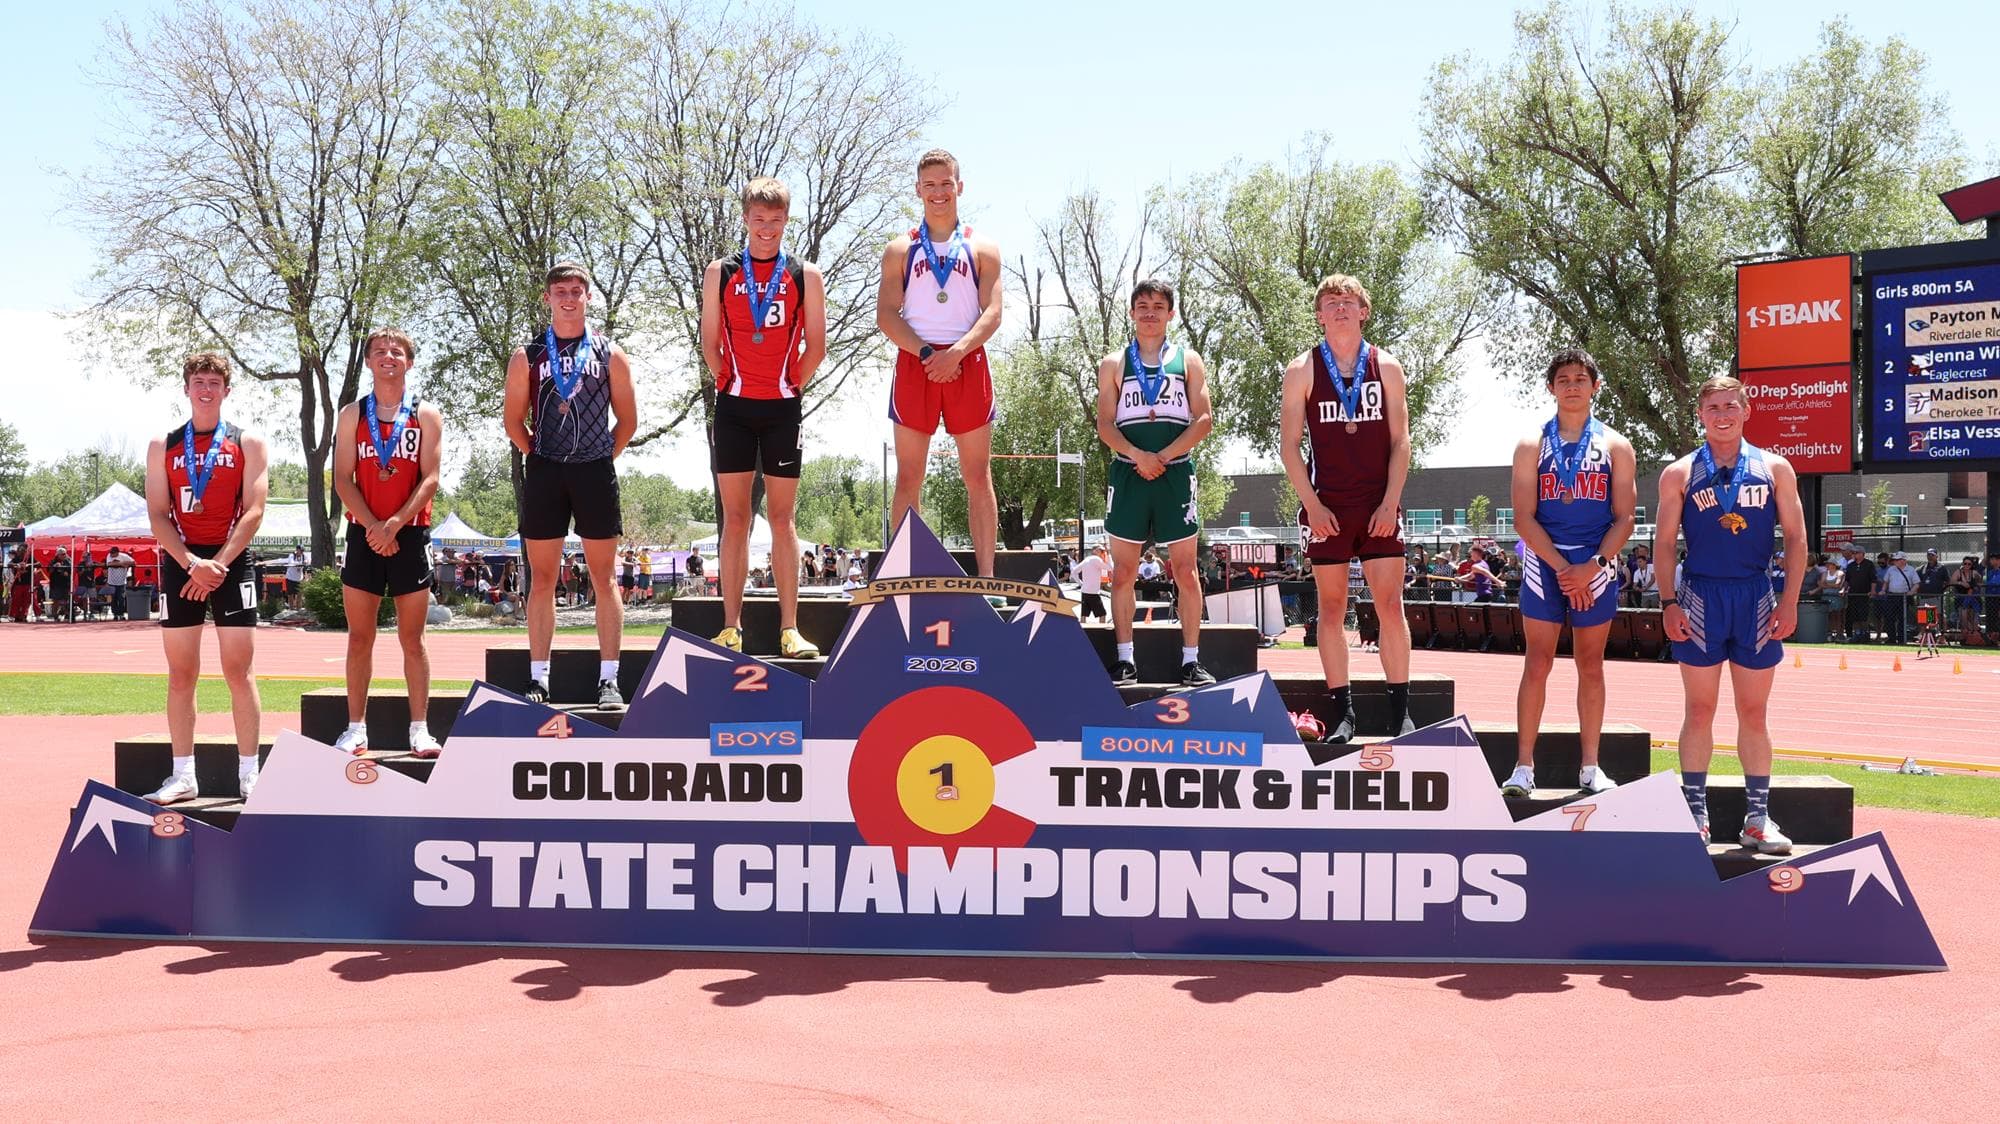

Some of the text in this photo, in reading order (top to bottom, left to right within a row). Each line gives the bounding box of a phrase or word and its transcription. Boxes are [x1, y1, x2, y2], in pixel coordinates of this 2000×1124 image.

[1876, 280, 1974, 299] Girls 800m 5A
[769, 303, 781, 325] 3
[1930, 310, 1985, 326] Payton
[1885, 323, 1892, 336] 1
[1929, 328, 1982, 341] Riverdale
[1885, 361, 1894, 373] 2
[1928, 350, 1975, 365] Jenna
[1929, 368, 1987, 382] Eaglecrest
[1159, 376, 1171, 399] 2
[1366, 383, 1378, 407] 6
[1761, 385, 1788, 400] Prep
[1790, 380, 1848, 399] Spotlight
[1930, 387, 1998, 402] Madison
[1756, 403, 1766, 411] We
[1767, 403, 1784, 411] cover
[1805, 399, 1832, 409] Athletics
[1885, 399, 1894, 412] 3
[1929, 407, 1983, 419] Cherokee
[405, 429, 417, 452] 8
[1884, 436, 1894, 449] 4
[1930, 426, 1960, 440] Elsa
[1590, 441, 1602, 462] 5
[1929, 446, 1970, 457] Golden
[1540, 472, 1608, 501] RAMS
[1745, 486, 1762, 506] 11
[184, 488, 195, 511] 7
[483, 539, 507, 547] CUBS
[1232, 545, 1263, 560] 110
[244, 584, 253, 607] 7
[875, 579, 1052, 598] STATE CHAMPION
[924, 620, 951, 647] 1
[907, 658, 977, 673] 2026
[733, 665, 768, 691] 2
[1155, 698, 1191, 724] 3
[537, 714, 573, 739] 4
[717, 731, 797, 747] BOYS
[1101, 737, 1247, 756] 800M RUN
[1359, 743, 1393, 771] 5
[345, 759, 379, 784] 6
[513, 761, 803, 803] COLORADO
[1050, 767, 1449, 811] TRACK & FIELD
[151, 812, 187, 839] 8
[1562, 804, 1597, 832] 7
[413, 840, 1527, 922] STATE CHAMPIONSHIPS
[1769, 866, 1804, 893] 9
